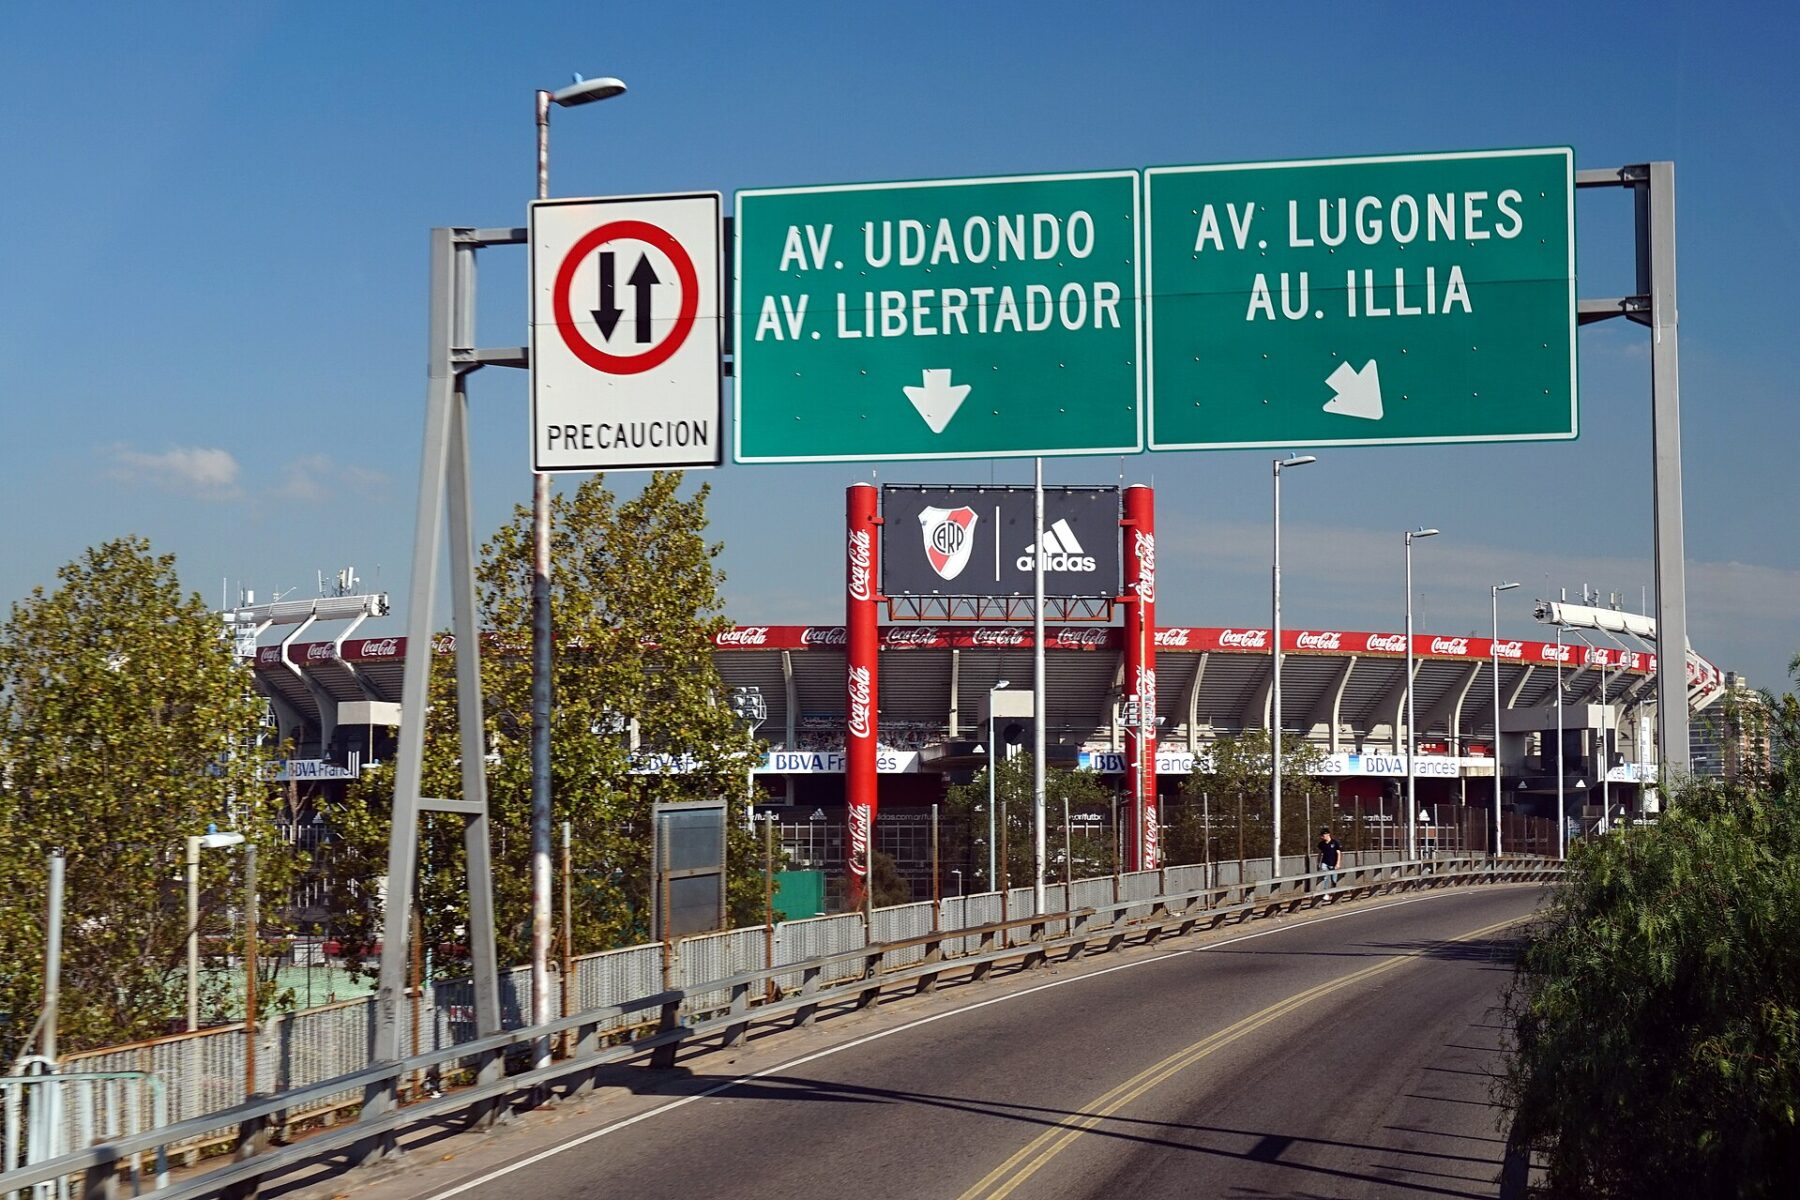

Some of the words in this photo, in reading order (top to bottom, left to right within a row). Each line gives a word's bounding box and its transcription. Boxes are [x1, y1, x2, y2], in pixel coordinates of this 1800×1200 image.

[780, 224, 845, 273] AV.
[865, 210, 1094, 269] UDAONDO
[1194, 202, 1267, 252] AV.
[1289, 189, 1523, 247] LUGONES
[755, 295, 821, 341] AV.
[837, 281, 1121, 339] LIBERTADOR
[1246, 271, 1324, 321] AU.
[1347, 265, 1472, 317] ILLIA
[548, 420, 708, 450] PRECAUCION
[776, 754, 824, 770] BBVA
[1366, 757, 1403, 773] BBVA
[1414, 760, 1456, 775] rancés
